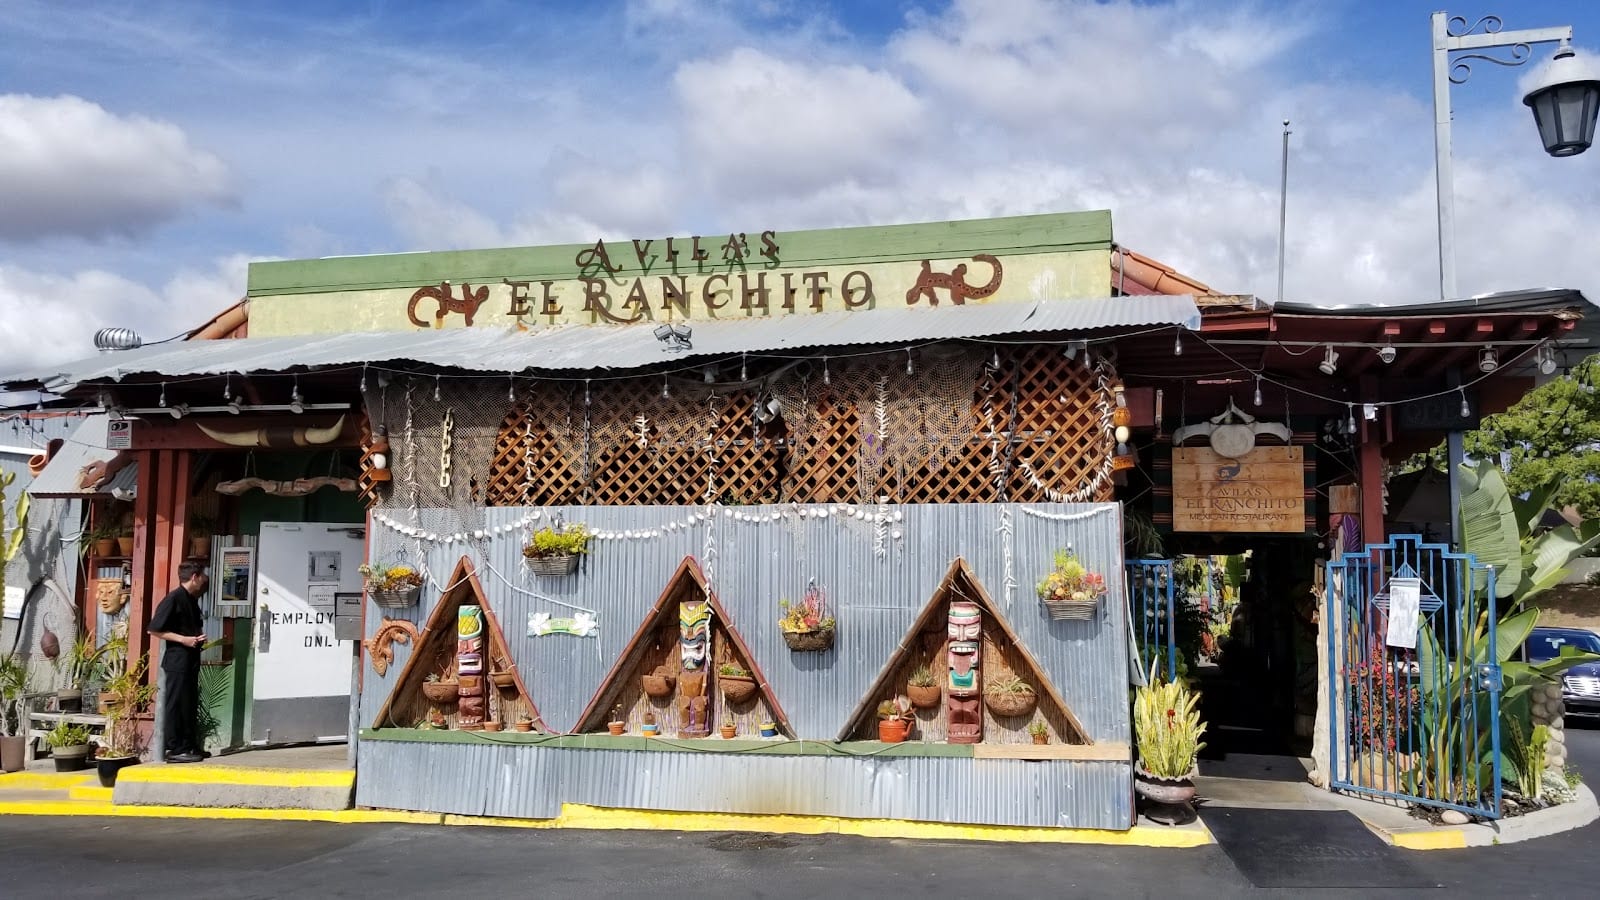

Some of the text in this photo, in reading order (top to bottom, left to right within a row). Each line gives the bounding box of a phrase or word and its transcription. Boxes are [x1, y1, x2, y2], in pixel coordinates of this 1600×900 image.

[575, 230, 780, 273] AVILA'S
[503, 269, 873, 323] EL RANCHITO
[1218, 486, 1262, 497] AVILA'S
[1186, 498, 1297, 513] EL RANCHITO
[1189, 513, 1289, 521] MEXICAN RESTAURANT
[272, 612, 335, 625] EMPLOY
